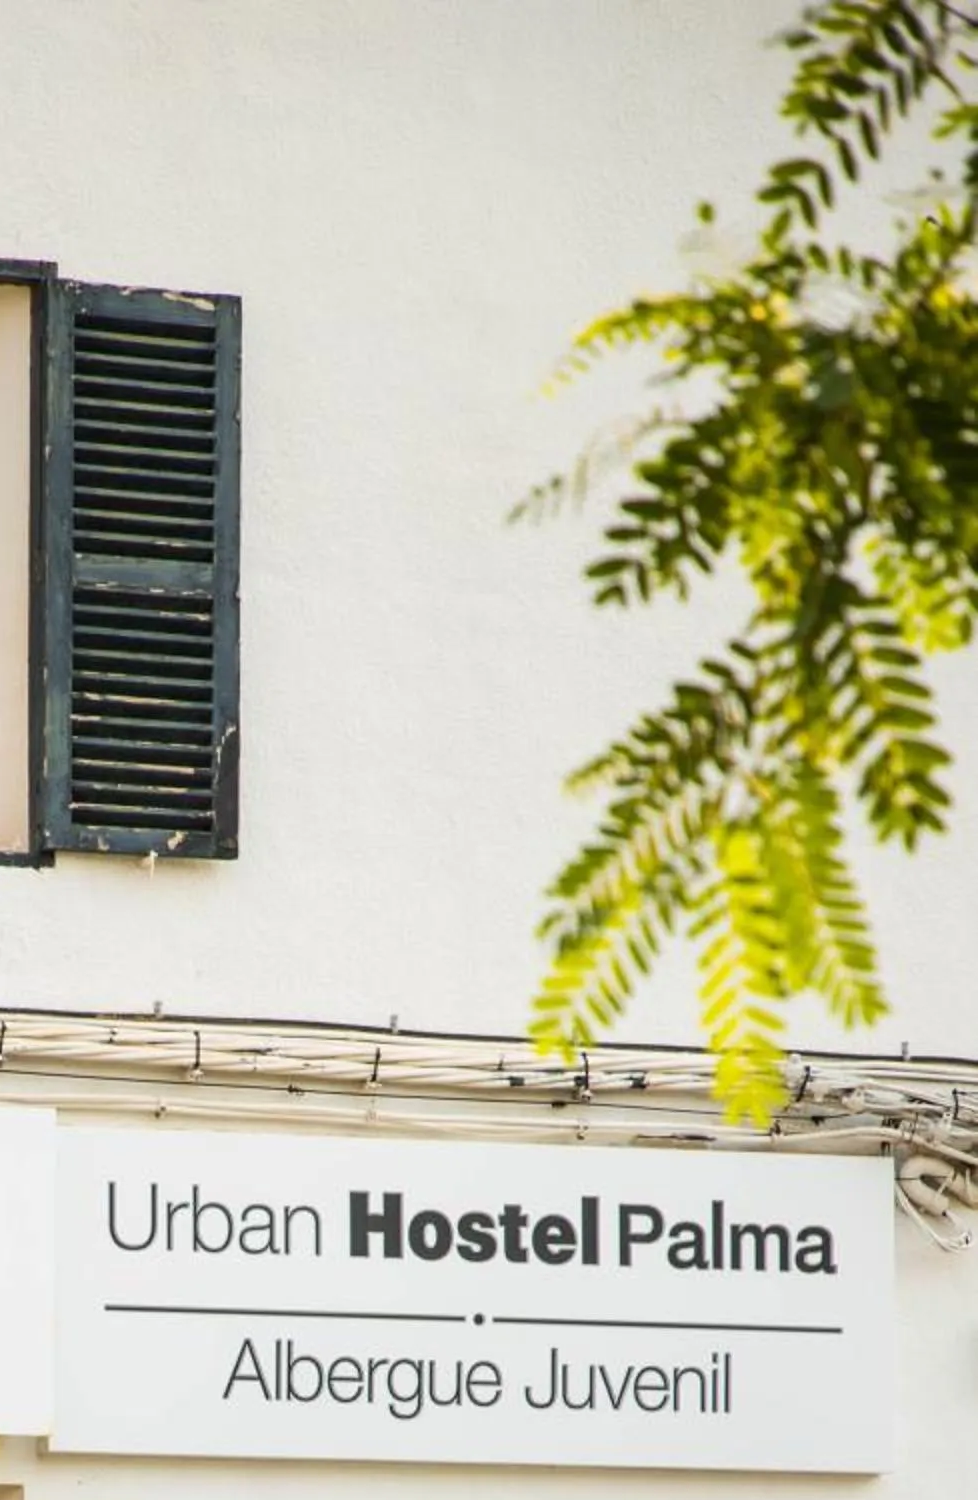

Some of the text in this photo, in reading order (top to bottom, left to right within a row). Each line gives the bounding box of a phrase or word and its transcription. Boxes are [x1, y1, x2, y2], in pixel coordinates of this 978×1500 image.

[107, 1181, 838, 1275] Urban Hostel Palma
[222, 1338, 733, 1420] Albergue Juvenil
